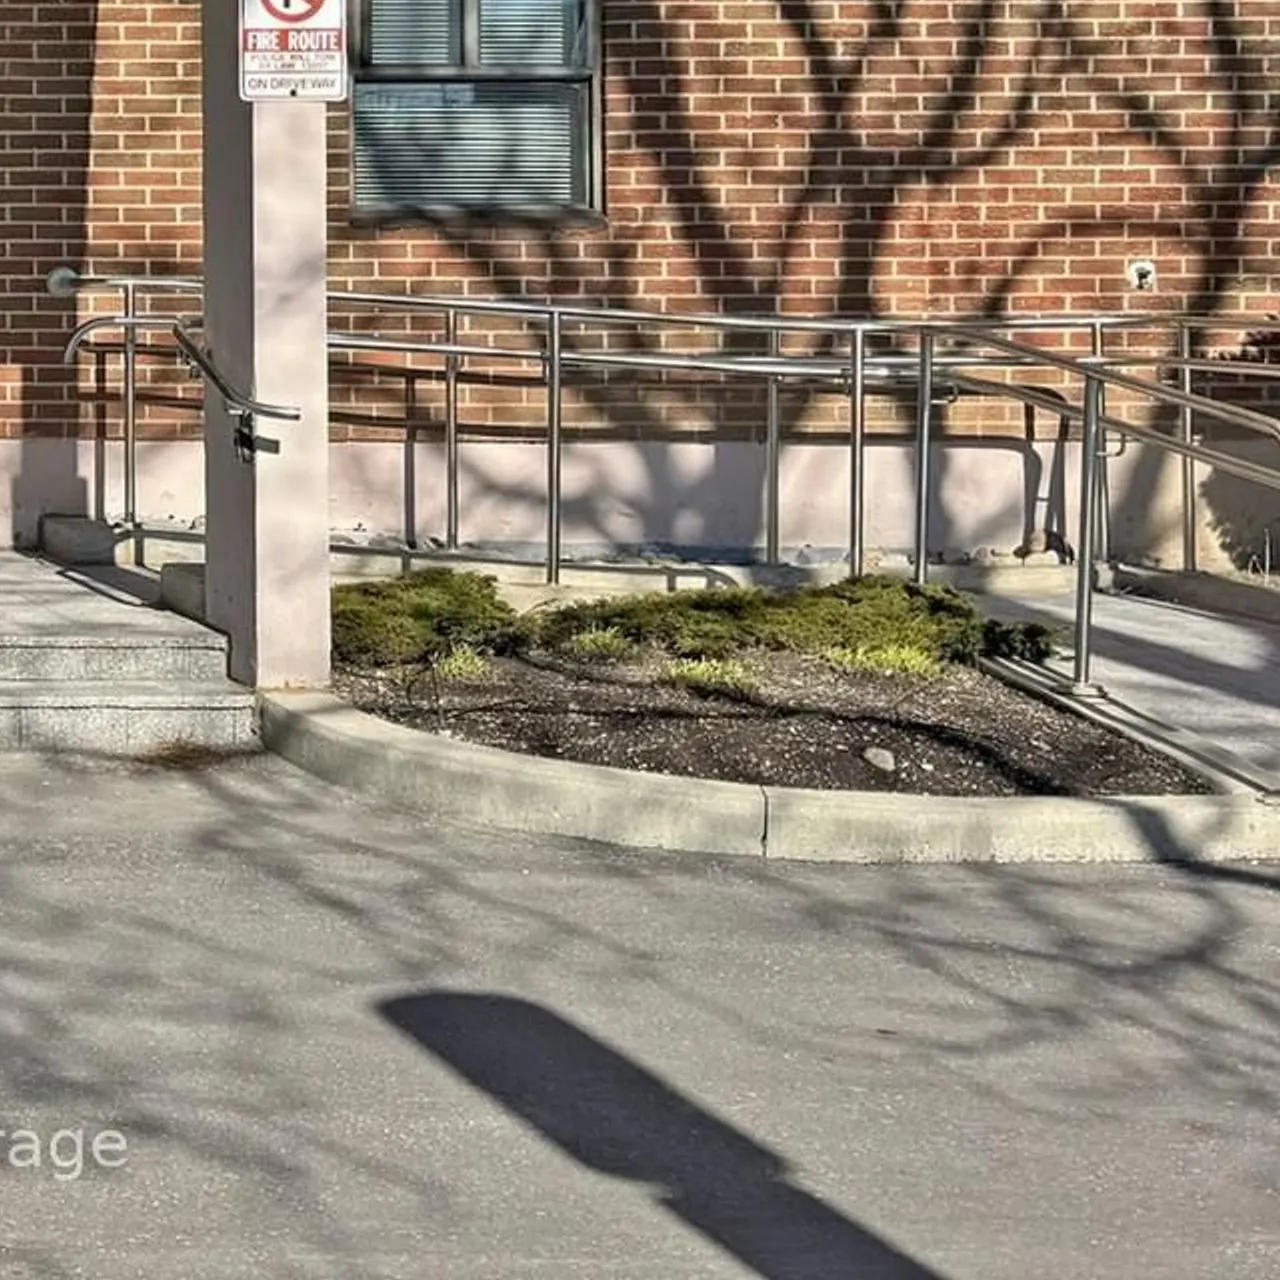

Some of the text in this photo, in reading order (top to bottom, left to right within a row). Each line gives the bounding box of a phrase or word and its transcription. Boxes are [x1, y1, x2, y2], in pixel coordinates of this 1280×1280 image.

[247, 31, 339, 50] FIRE ROUTE
[247, 77, 268, 90] ON
